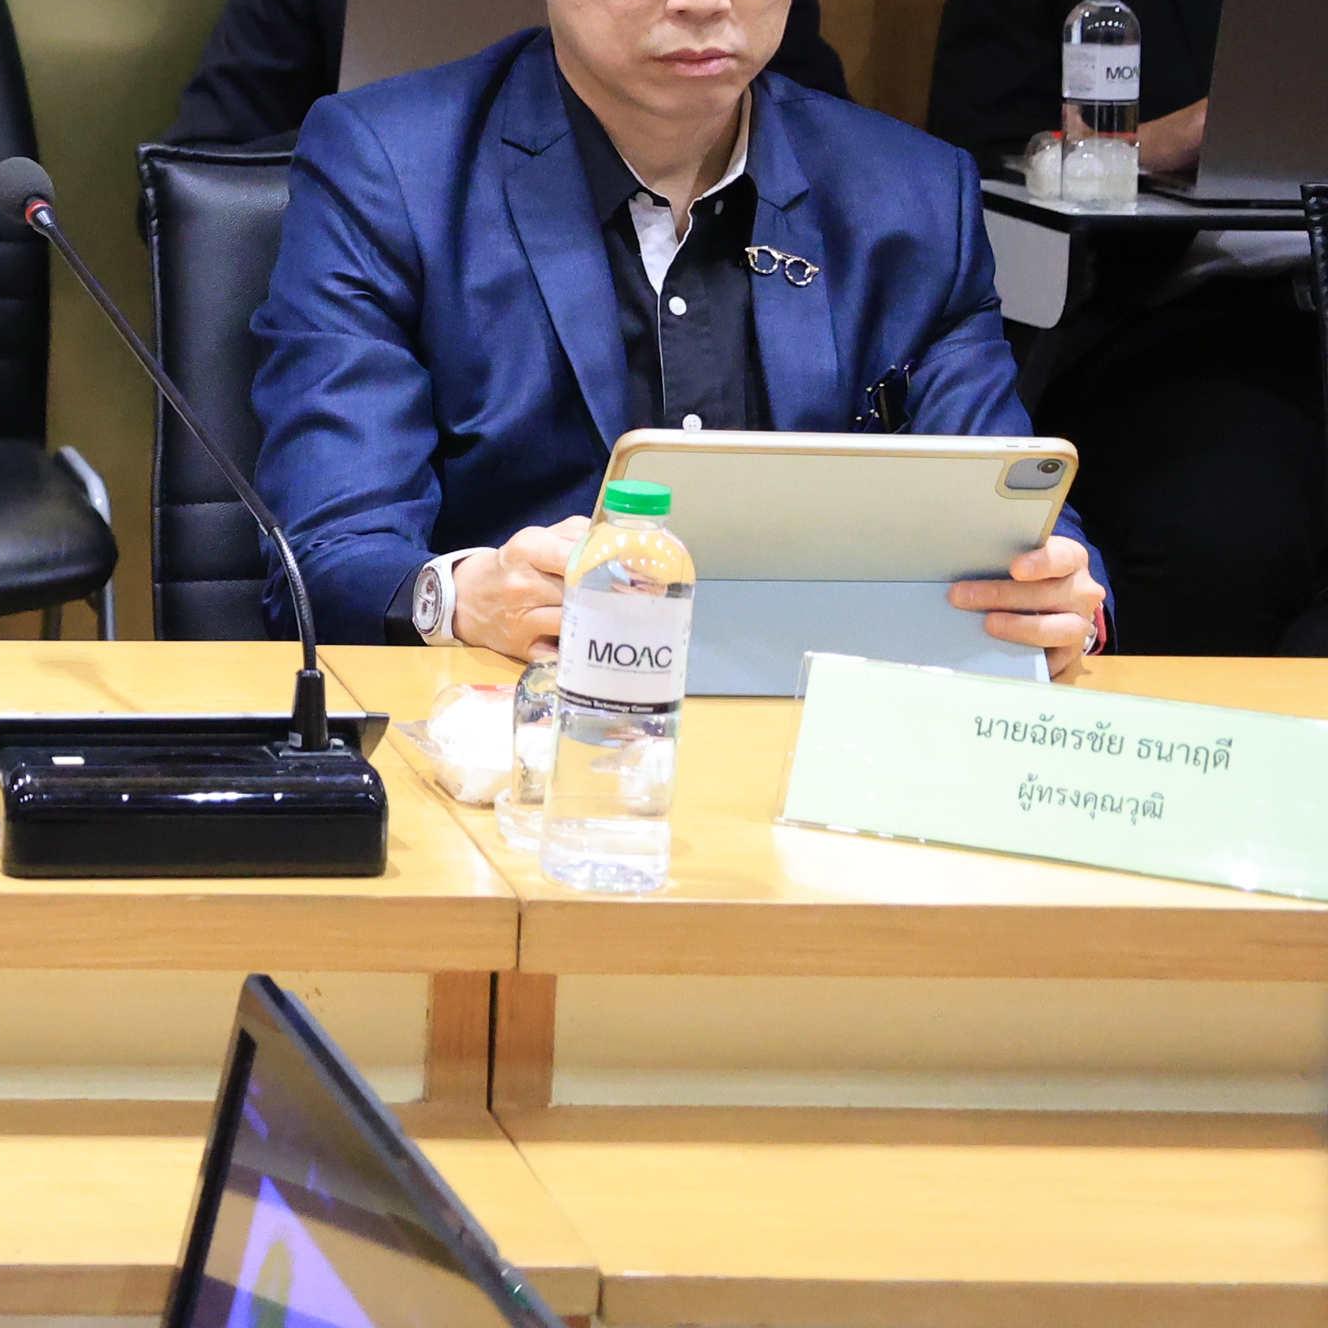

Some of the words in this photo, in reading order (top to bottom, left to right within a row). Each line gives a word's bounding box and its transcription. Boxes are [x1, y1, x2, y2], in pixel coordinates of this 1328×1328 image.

[588, 639, 673, 668] MOAC
[974, 714, 1125, 756] นายฉัตรชัย
[1137, 737, 1233, 774] ธนาฤดี
[1017, 773, 1165, 826] ผู้ทรงคุณวุฒิ
